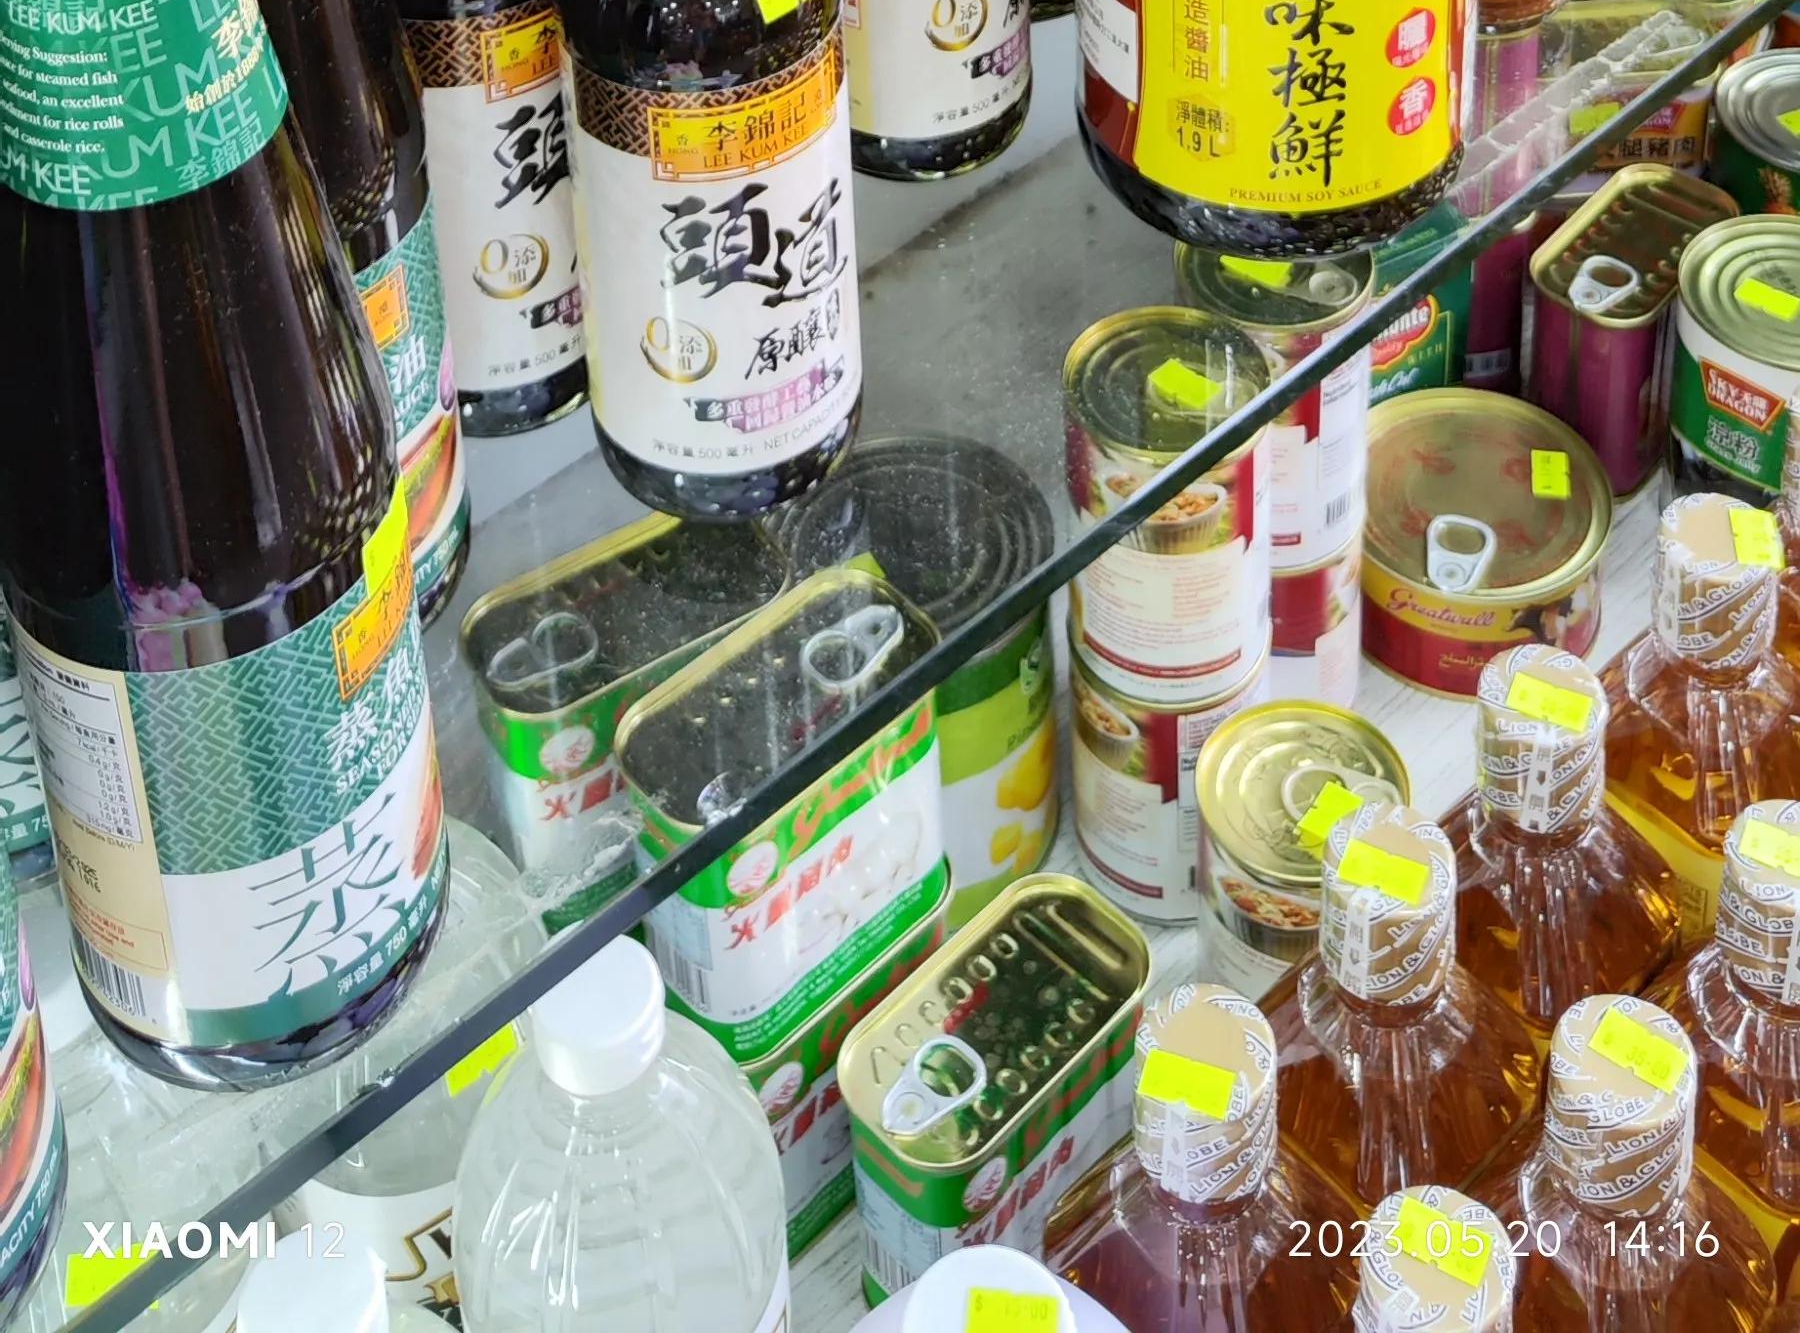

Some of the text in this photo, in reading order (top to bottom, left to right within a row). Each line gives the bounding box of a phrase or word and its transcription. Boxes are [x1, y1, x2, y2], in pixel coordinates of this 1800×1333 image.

[8, 0, 40, 31] LEE
[32, 45, 108, 70] Suggestion:
[35, 68, 89, 86] steamed
[92, 70, 118, 86] fish
[42, 92, 125, 109] an excellent
[1397, 80, 1430, 122] 香
[42, 114, 125, 131] for rice rolls
[705, 95, 807, 152] 李錦記
[20, 131, 106, 155] casserole rice.
[702, 122, 810, 170] LEE KUM KEE
[1228, 178, 1384, 204] PREMIUM SOY SAUCE
[659, 176, 850, 309] 頭道
[698, 445, 723, 461] 500
[247, 791, 409, 1005] 蒸
[334, 952, 385, 998] 淨容量
[383, 926, 409, 960] 750
[1607, 1129, 1659, 1155] LION
[1191, 1161, 1237, 1195] LION
